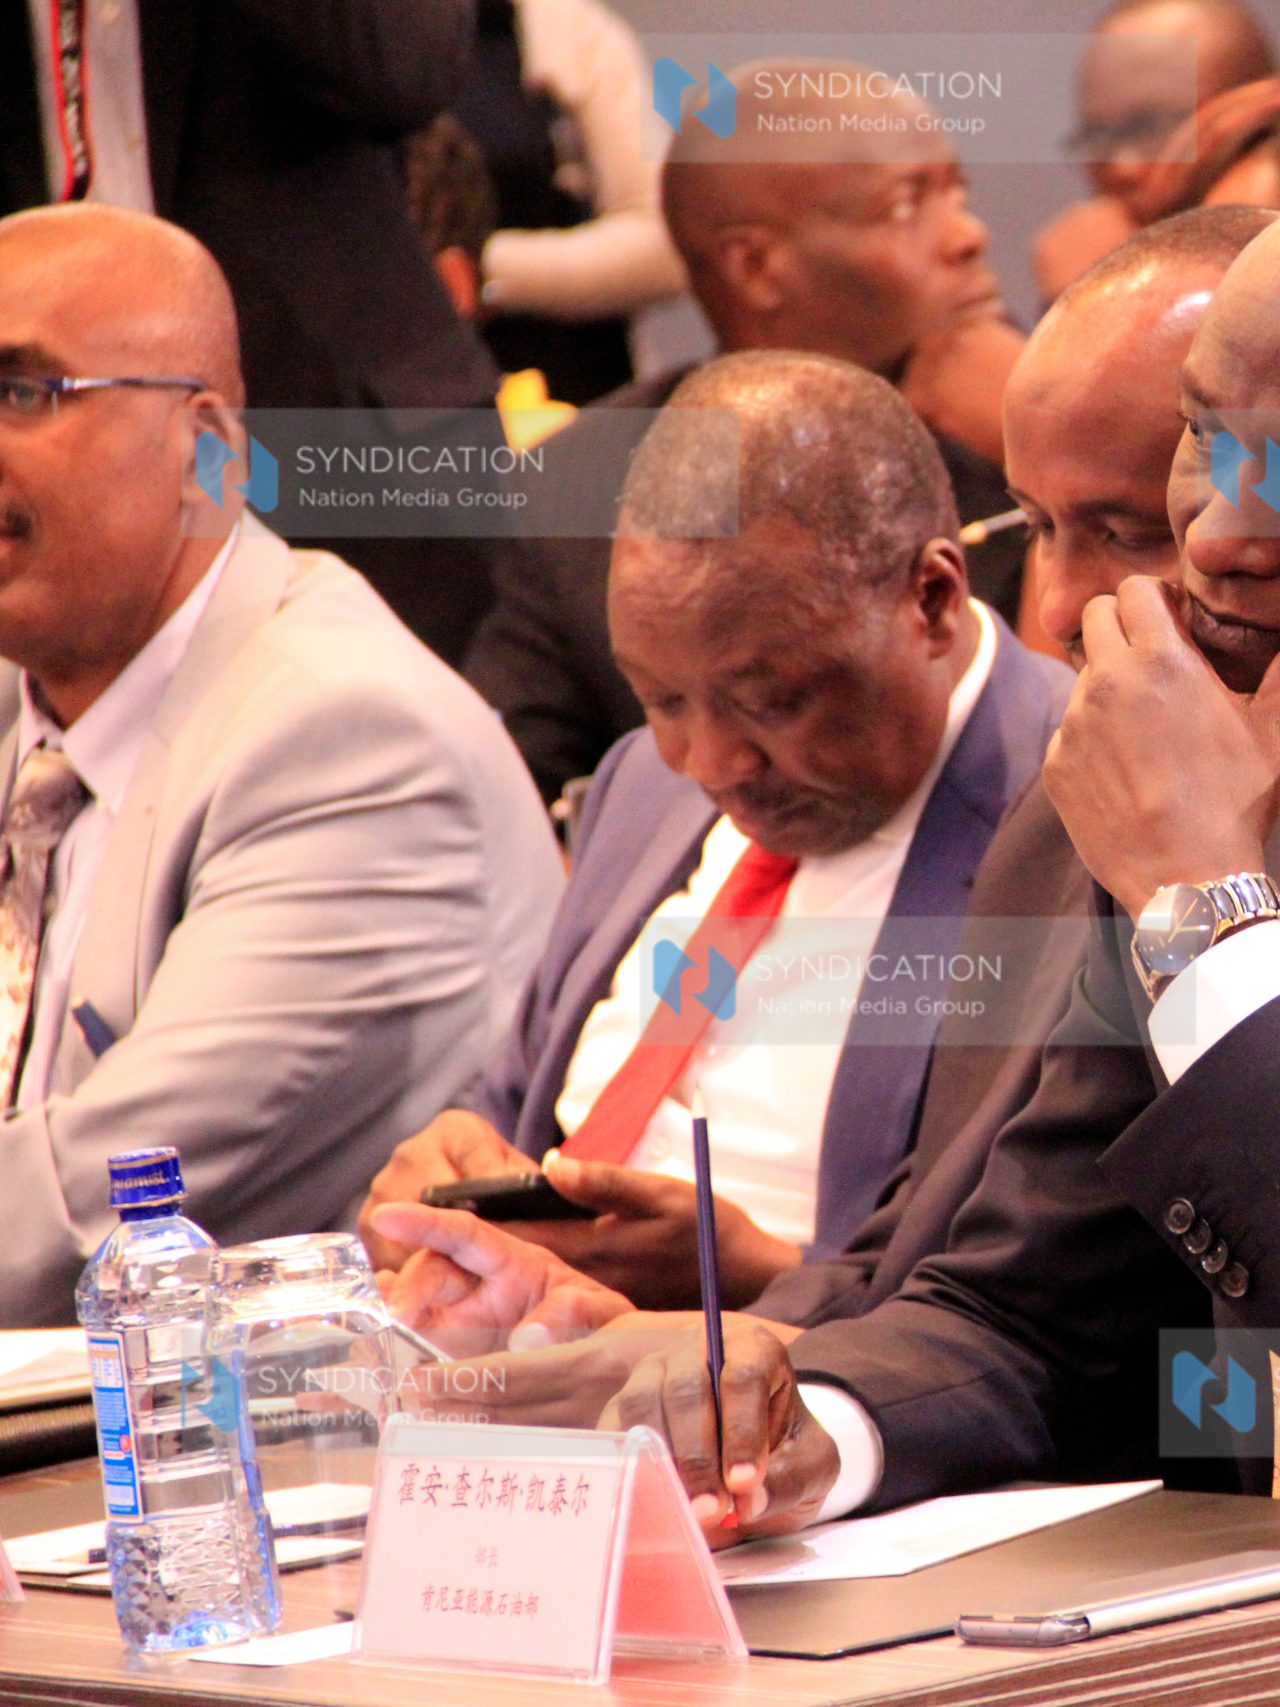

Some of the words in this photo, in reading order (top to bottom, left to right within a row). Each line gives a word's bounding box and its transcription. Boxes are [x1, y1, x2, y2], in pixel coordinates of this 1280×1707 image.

[421, 1584, 541, 1622] 肯尼亚能源石油部
